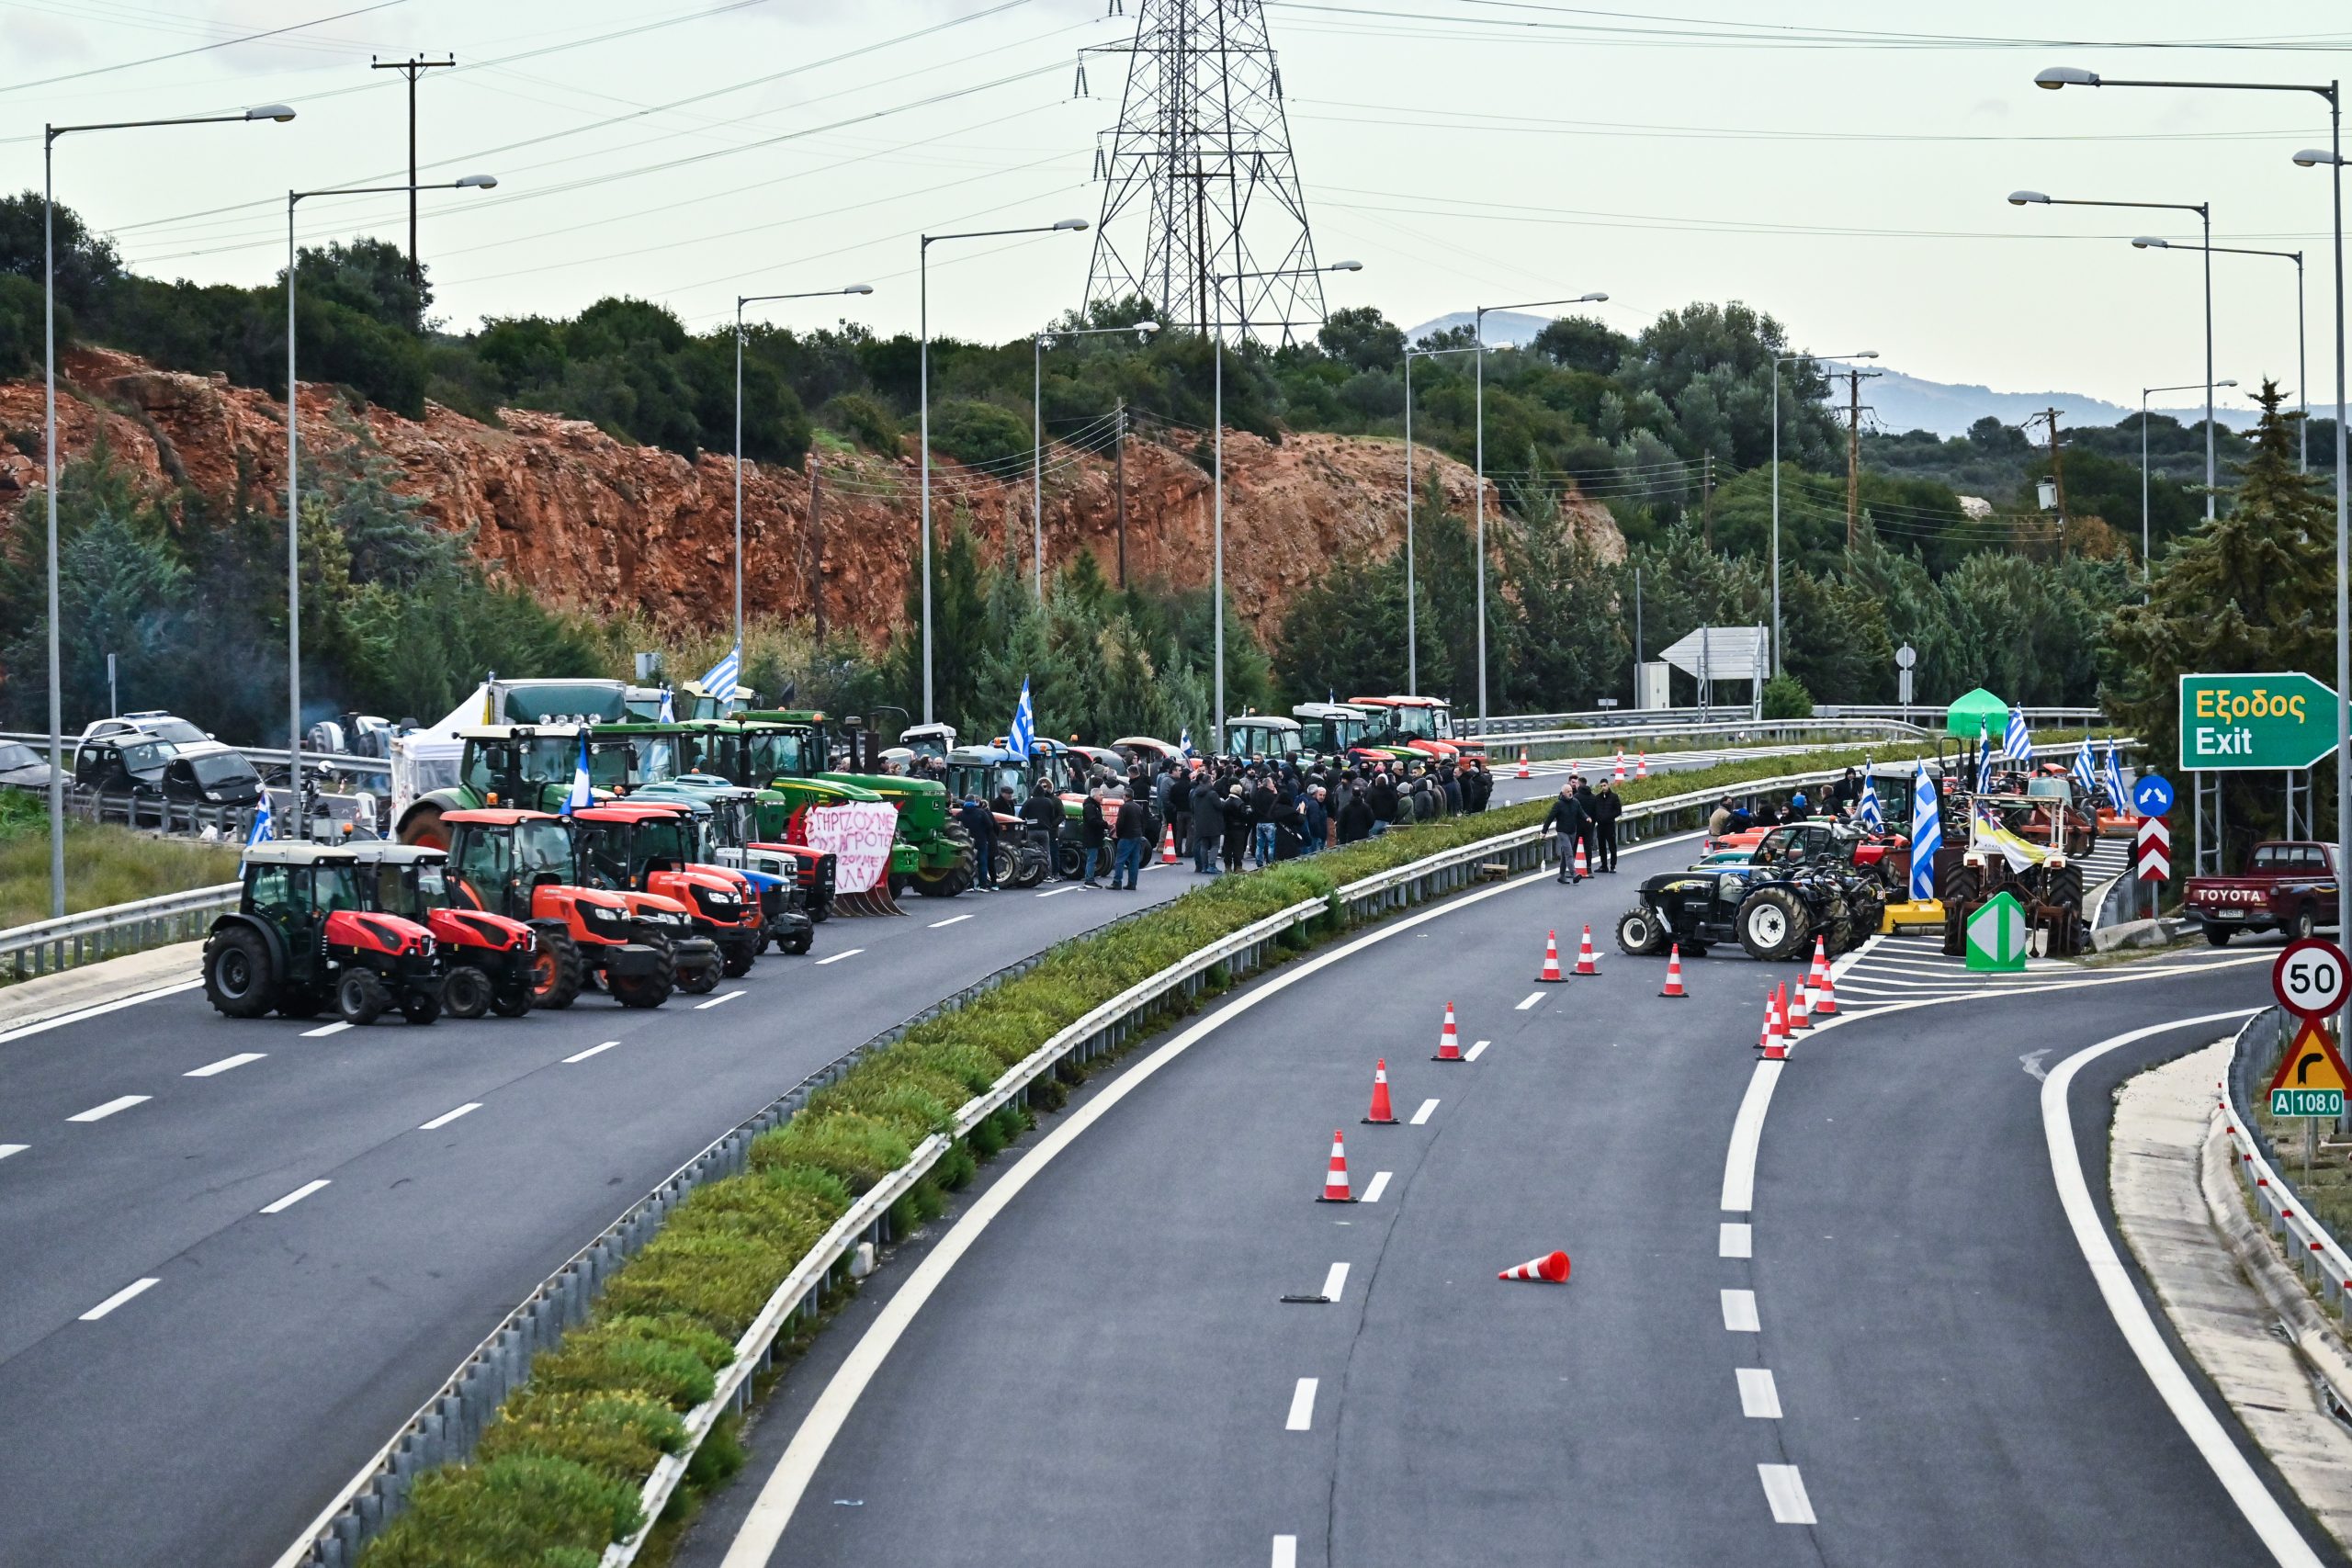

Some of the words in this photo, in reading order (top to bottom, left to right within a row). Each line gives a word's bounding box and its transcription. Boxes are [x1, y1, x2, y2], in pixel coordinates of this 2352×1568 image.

[2196, 689, 2306, 725] Εξοδος
[2196, 727, 2253, 755] Exit
[2198, 889, 2261, 902] TOYOTA
[2290, 964, 2335, 994] 50
[2275, 1093, 2290, 1112] A
